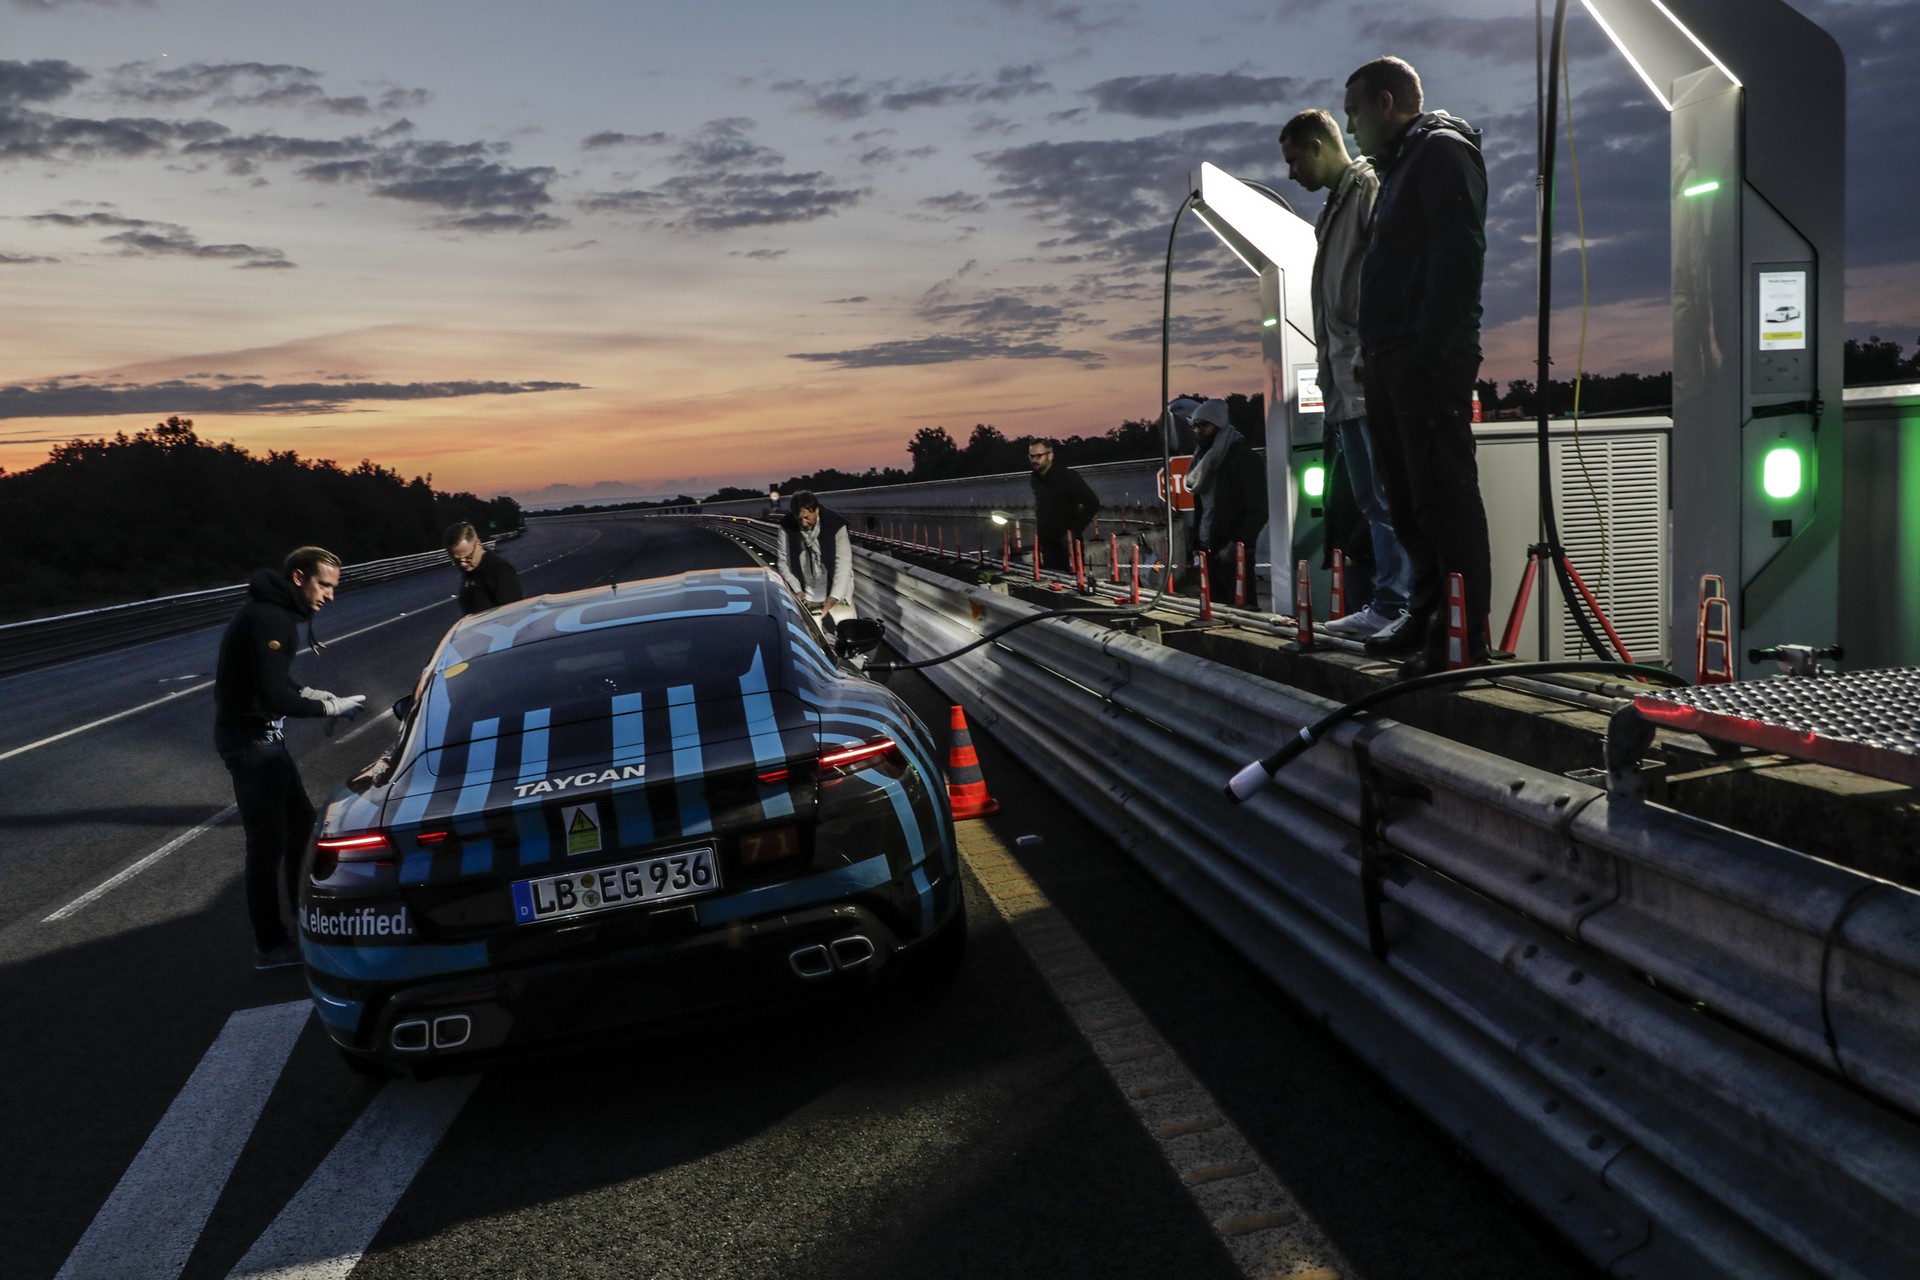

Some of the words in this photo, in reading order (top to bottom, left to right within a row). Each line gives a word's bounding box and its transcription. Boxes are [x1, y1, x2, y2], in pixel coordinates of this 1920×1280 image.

[514, 764, 646, 798] TAYCAN
[532, 879, 578, 914] LB
[599, 867, 643, 903] EG
[649, 854, 711, 893] 936
[310, 906, 413, 936] electrified.
